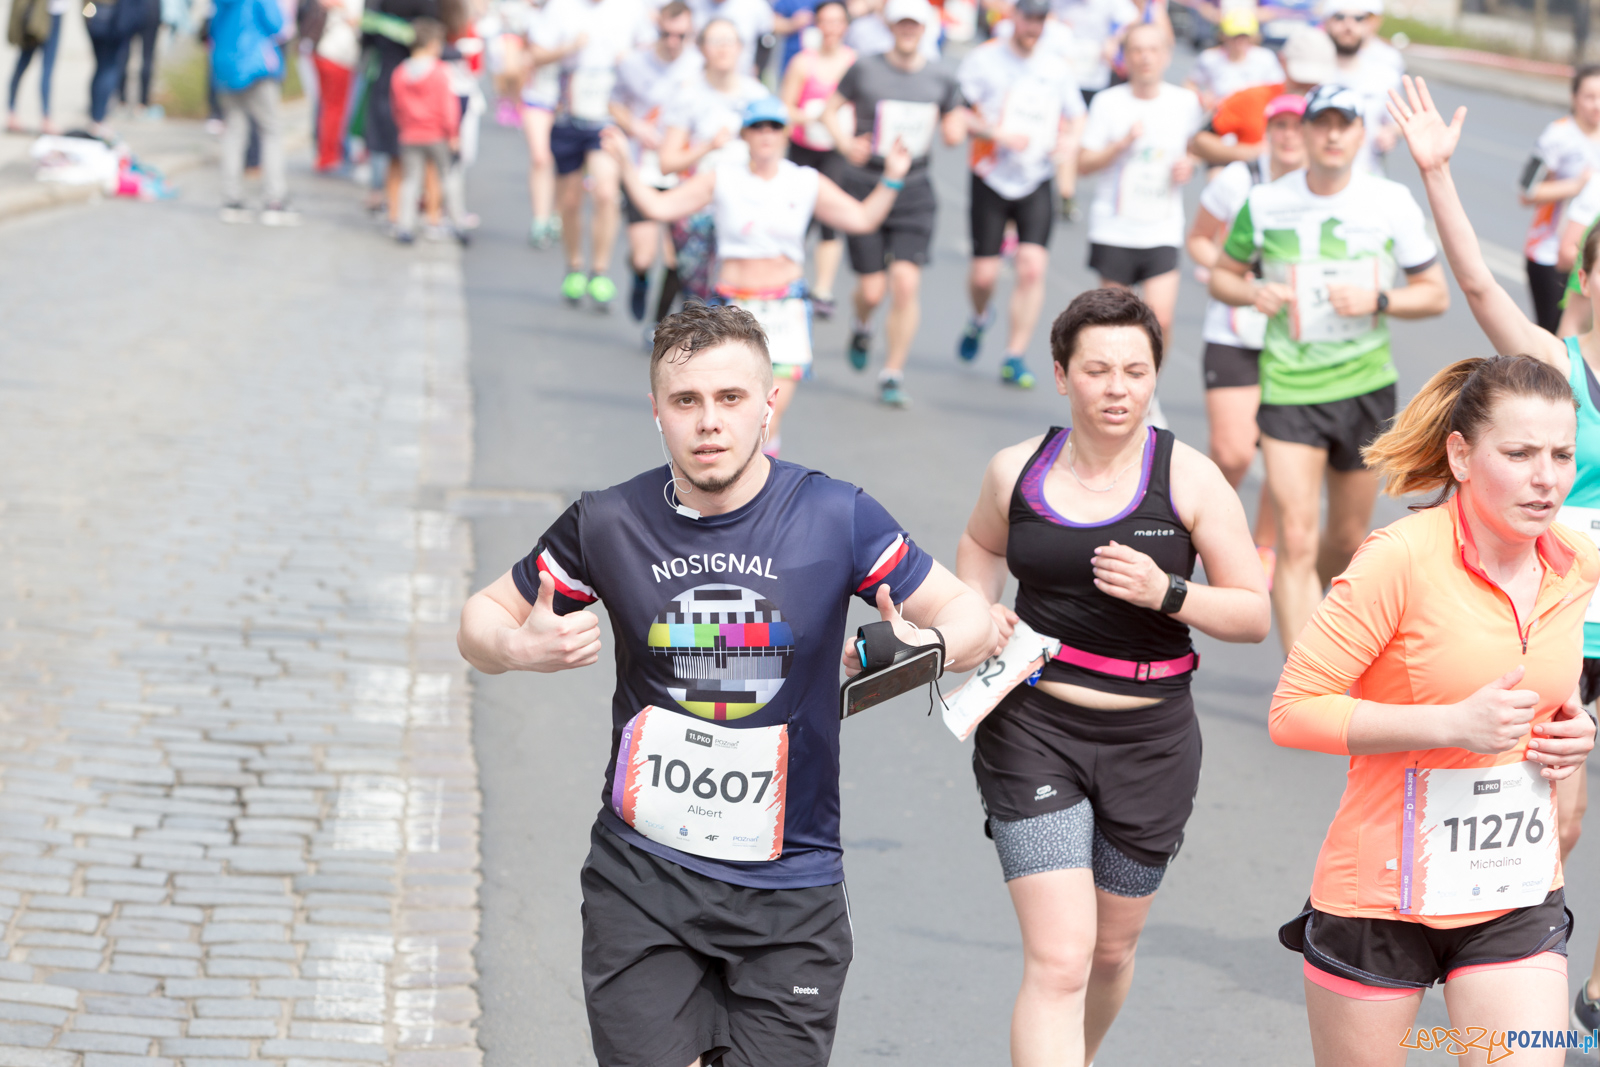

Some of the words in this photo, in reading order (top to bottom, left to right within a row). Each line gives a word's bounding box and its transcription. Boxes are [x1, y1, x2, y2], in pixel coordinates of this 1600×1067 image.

[1133, 528, 1175, 537] martes
[651, 552, 778, 583] NOSIGNAL
[696, 734, 711, 744] PKO
[647, 754, 774, 804] 10607
[1485, 783, 1499, 791] PKO
[687, 804, 722, 819] Albert
[1443, 807, 1544, 853] 11276
[704, 834, 720, 842] 4F
[1470, 857, 1522, 870] Michalina
[1496, 884, 1510, 893] 4F
[793, 985, 819, 995] Reebok
